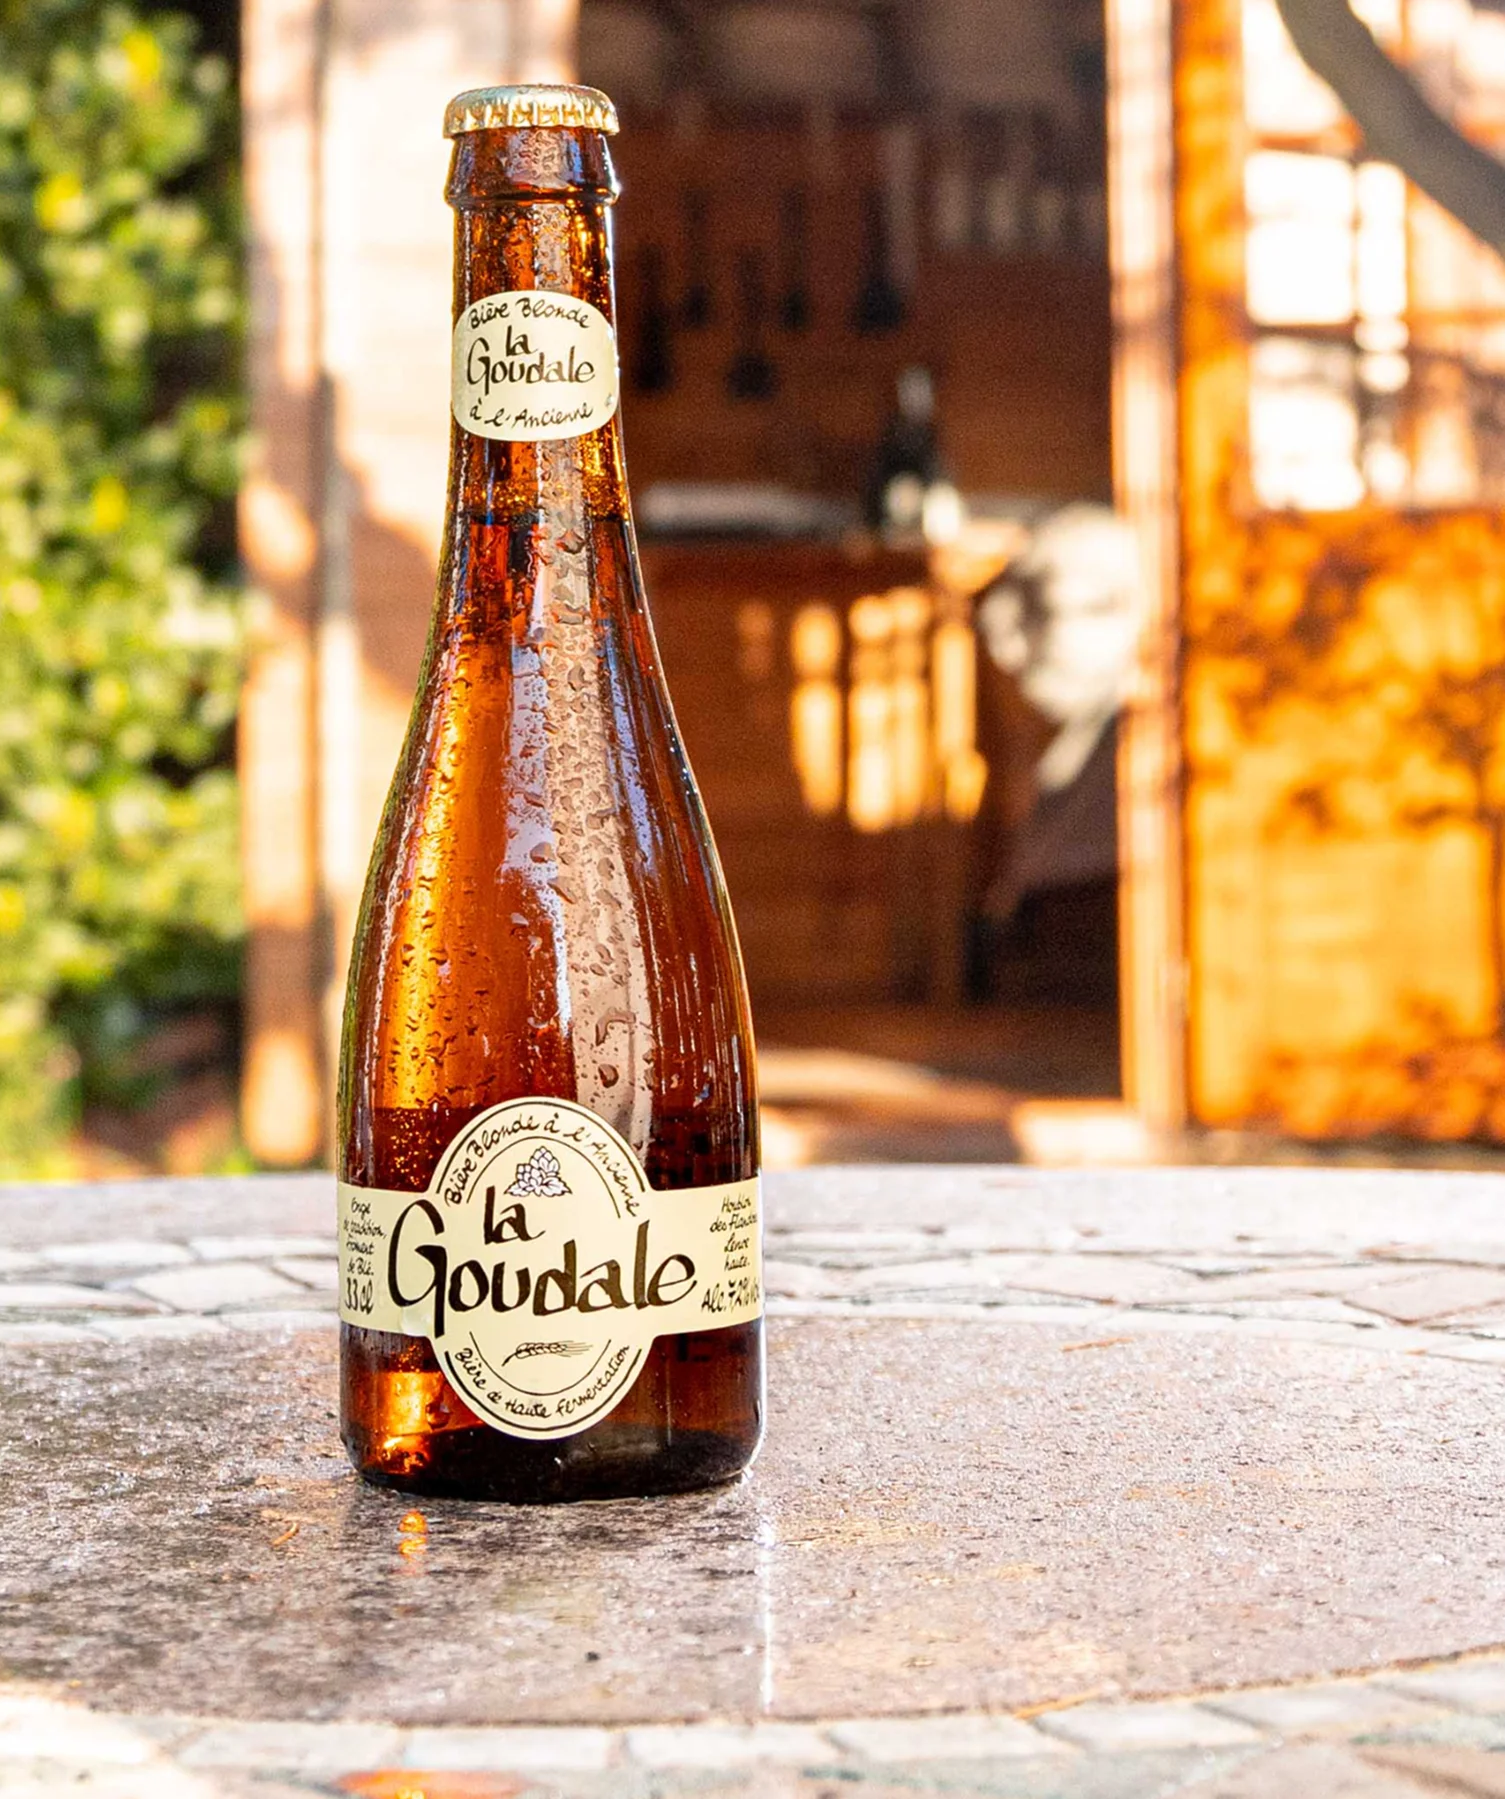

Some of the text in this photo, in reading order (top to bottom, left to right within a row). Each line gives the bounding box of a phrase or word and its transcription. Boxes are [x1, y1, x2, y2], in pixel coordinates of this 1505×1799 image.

[468, 297, 590, 329] Bière Blonde
[506, 325, 538, 357] la
[467, 337, 596, 396] Goudale
[470, 398, 483, 420] à
[444, 1158, 477, 1207] Bière
[466, 1114, 541, 1158] Blonde
[543, 1112, 560, 1134] à
[483, 1186, 546, 1245] la
[388, 1199, 697, 1339] Goudale
[455, 1347, 486, 1390] Bière
[504, 1398, 551, 1419] Haute
